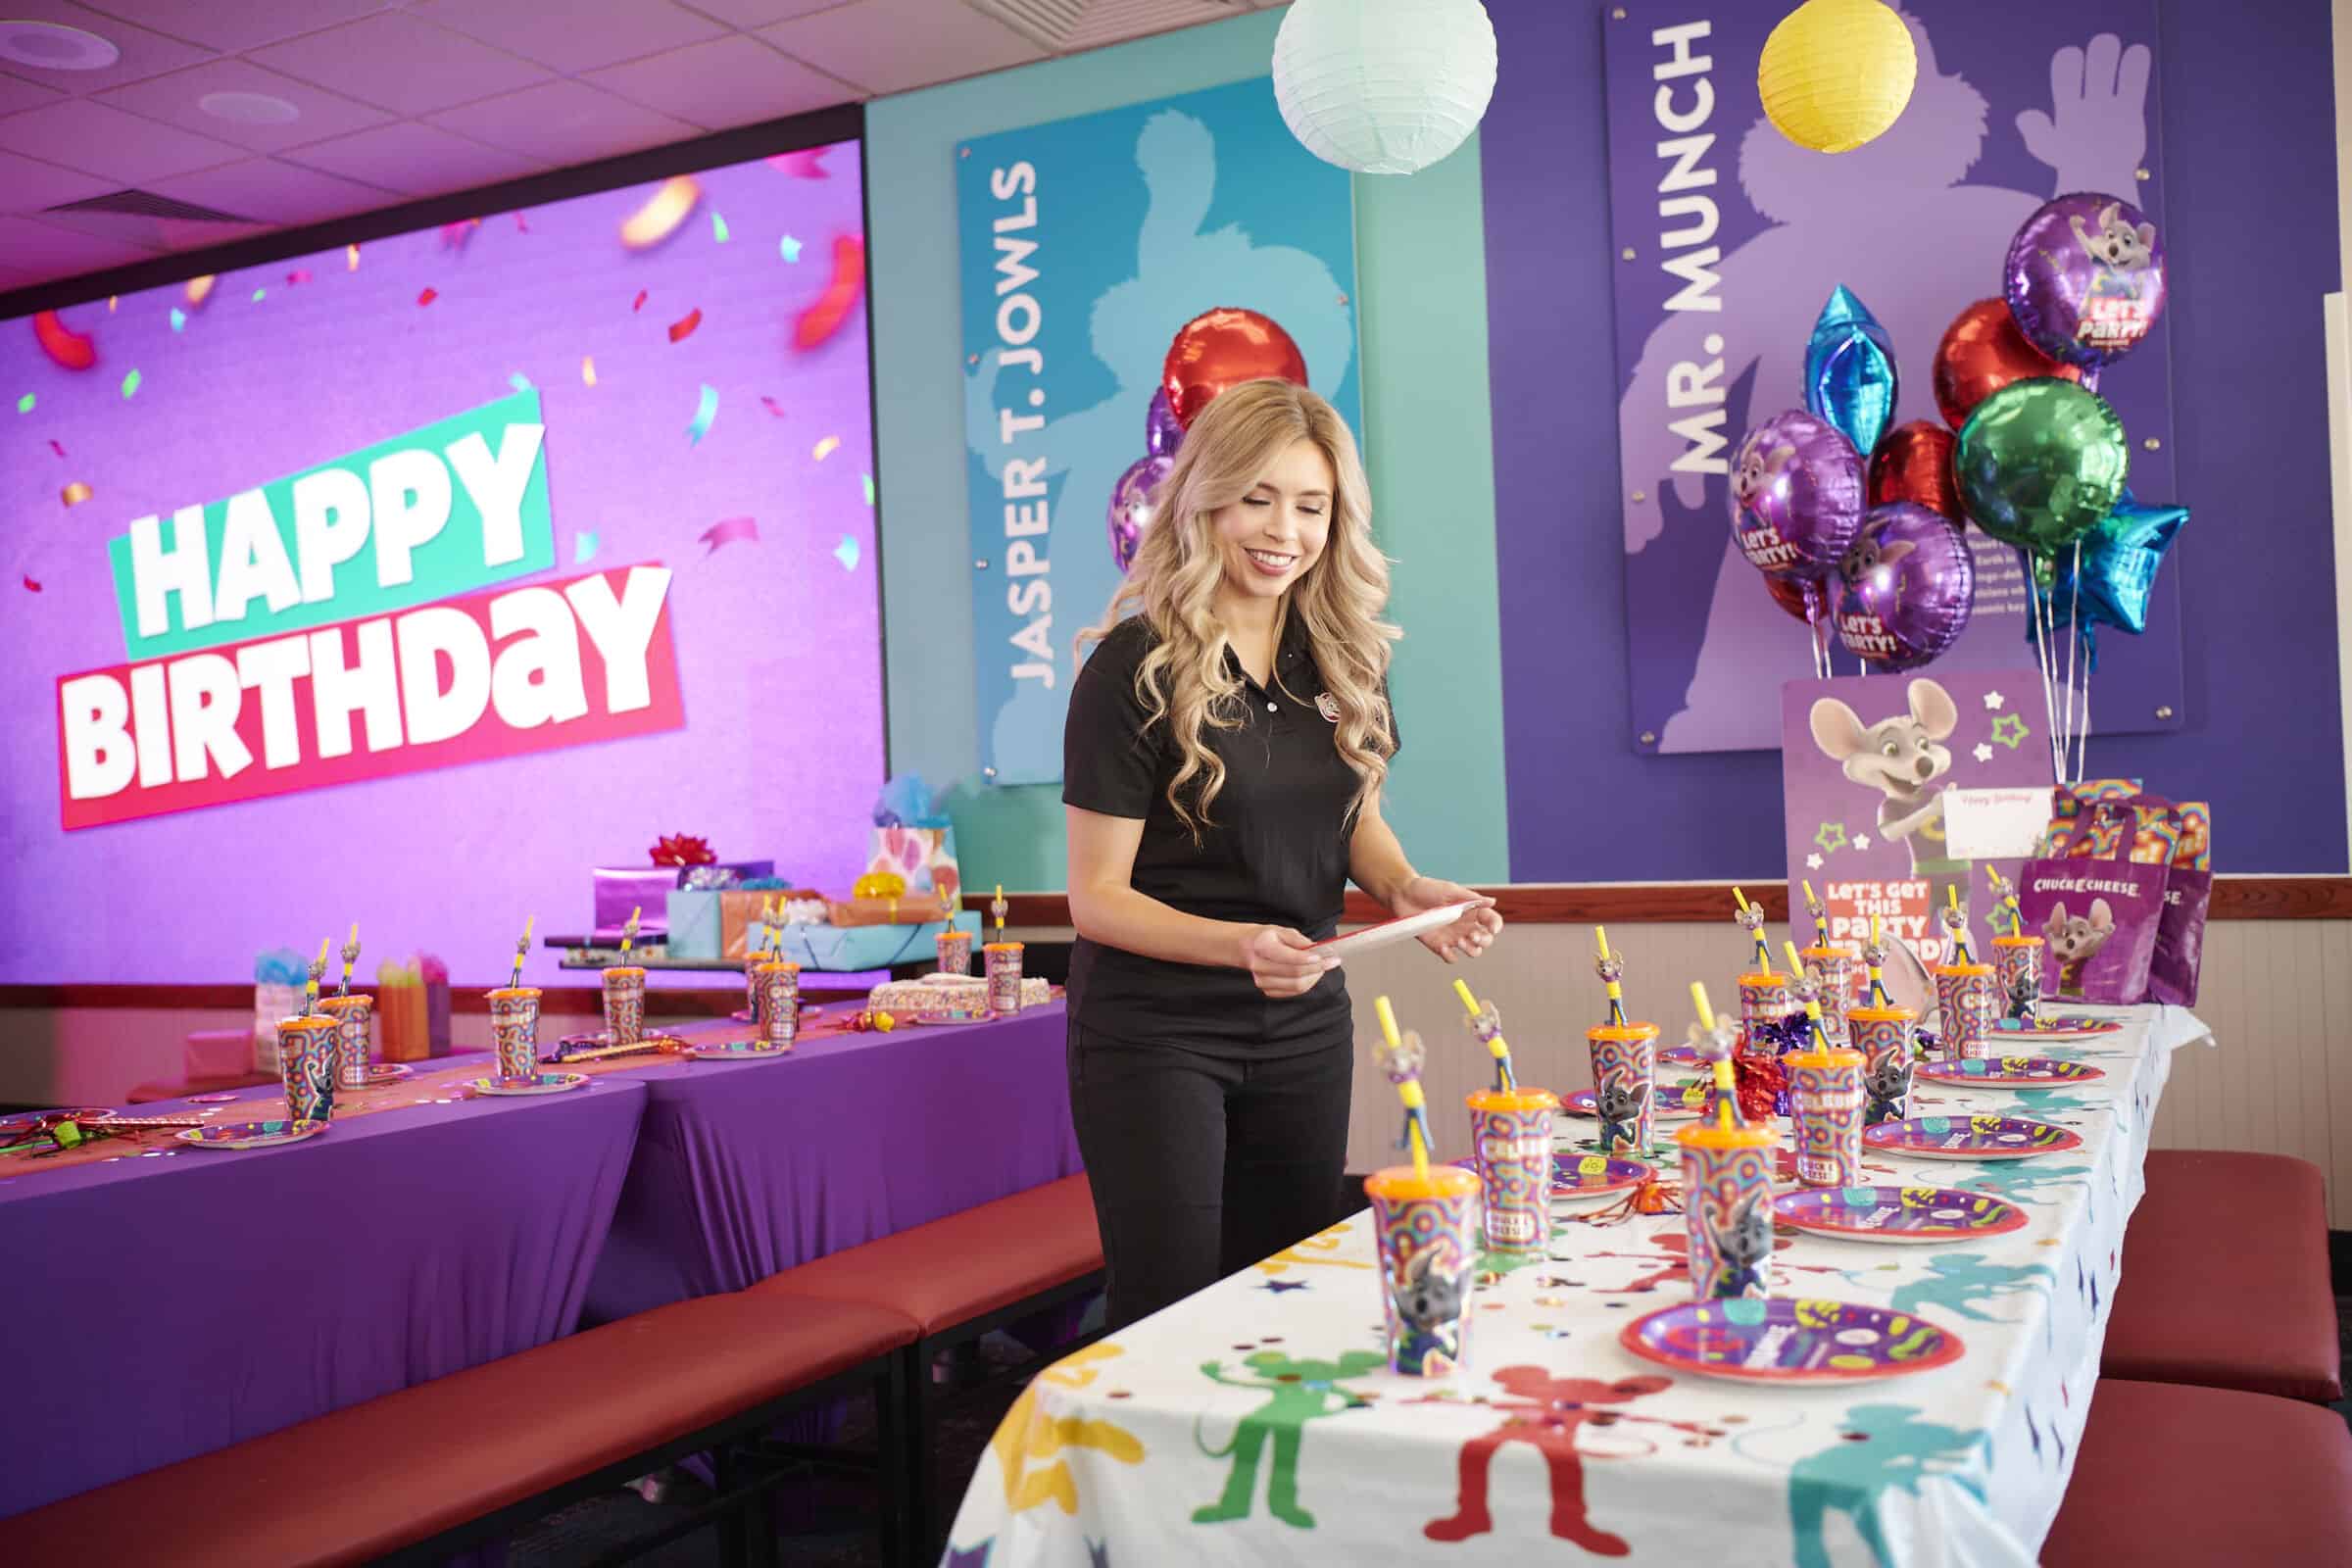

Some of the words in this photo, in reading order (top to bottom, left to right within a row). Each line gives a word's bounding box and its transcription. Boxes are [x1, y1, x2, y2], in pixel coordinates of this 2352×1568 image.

[1652, 20, 1723, 313] MUNCH
[992, 161, 1043, 374] JOWLS
[1003, 388, 1045, 444] T.
[1667, 333, 1729, 475] MR.
[129, 422, 546, 639] HAPPY
[1004, 456, 1054, 689] JASPER
[1854, 900, 1902, 916] THIS
[2034, 878, 2074, 893] CHUCK
